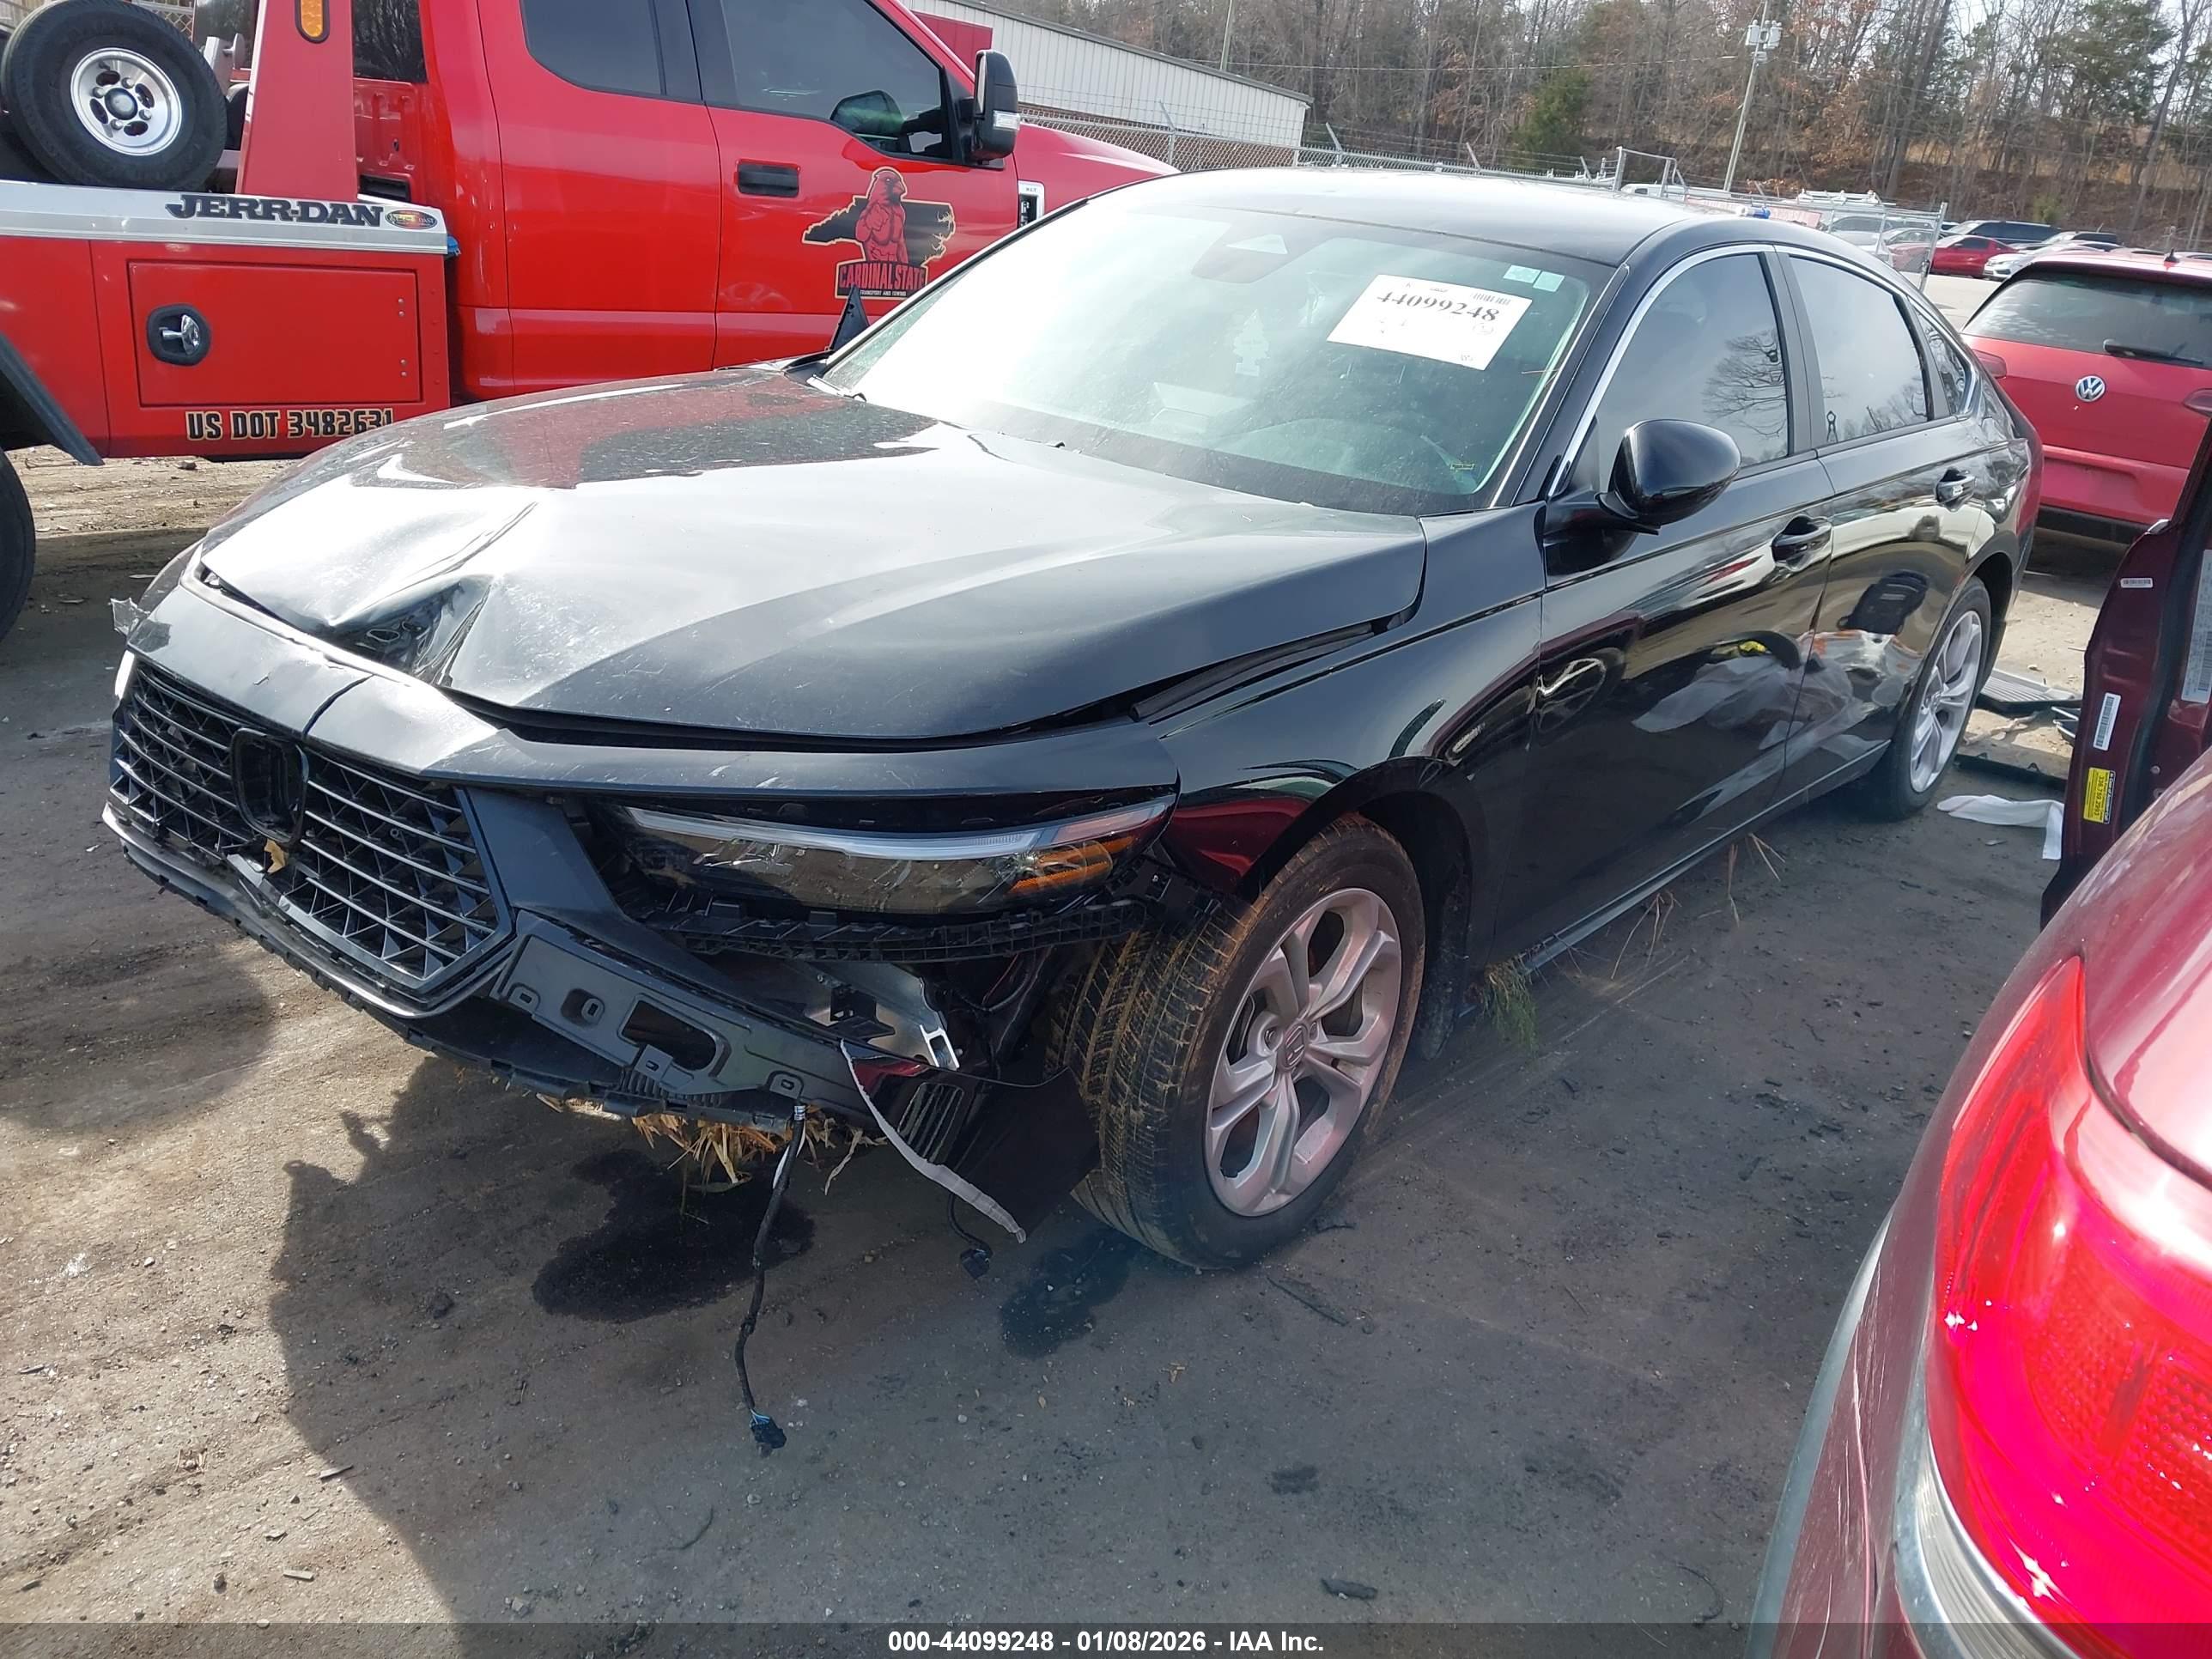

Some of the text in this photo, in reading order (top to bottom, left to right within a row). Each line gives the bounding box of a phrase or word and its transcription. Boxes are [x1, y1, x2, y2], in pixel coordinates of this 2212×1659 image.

[165, 194, 384, 227] JERR-DAN
[839, 263, 893, 289] CARDINAL
[1376, 290, 1500, 322] 44099248
[185, 408, 394, 441] US DOT 3482631
